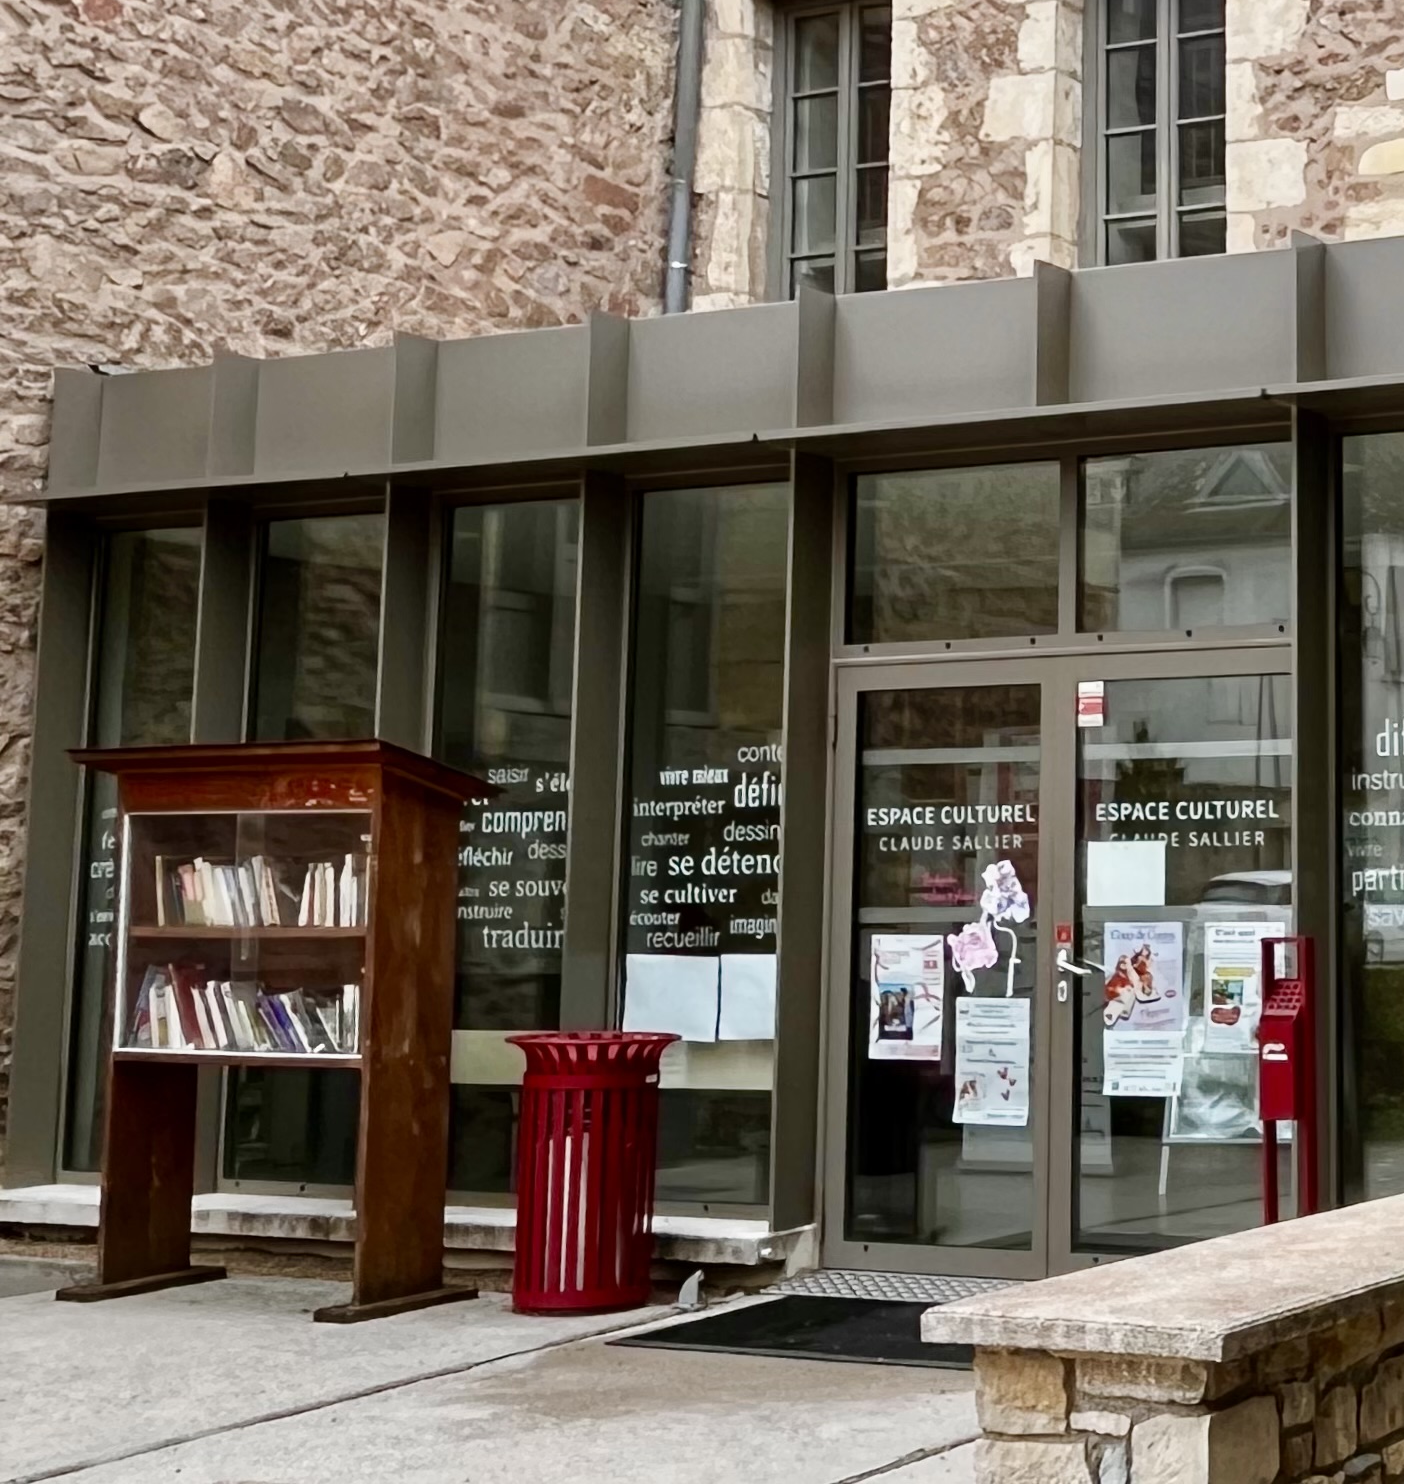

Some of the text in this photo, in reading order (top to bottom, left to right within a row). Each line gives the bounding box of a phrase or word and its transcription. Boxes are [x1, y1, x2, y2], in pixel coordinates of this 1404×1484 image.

[633, 795, 726, 821] interpréter
[867, 804, 1036, 826] ESPACE CULTUREL
[1095, 800, 1280, 822] ESPACE CULTUREL
[482, 810, 567, 840] compren
[723, 820, 781, 842] dessin
[879, 835, 1022, 852] CLAUDE SALLIER
[1188, 830, 1265, 847] SALLIER
[630, 855, 657, 877] lire
[667, 855, 694, 876] se
[488, 880, 510, 897] se
[640, 883, 737, 904] se cultiver
[629, 910, 681, 926] écouter
[482, 921, 564, 948] traduir
[646, 926, 721, 948] recueillir
